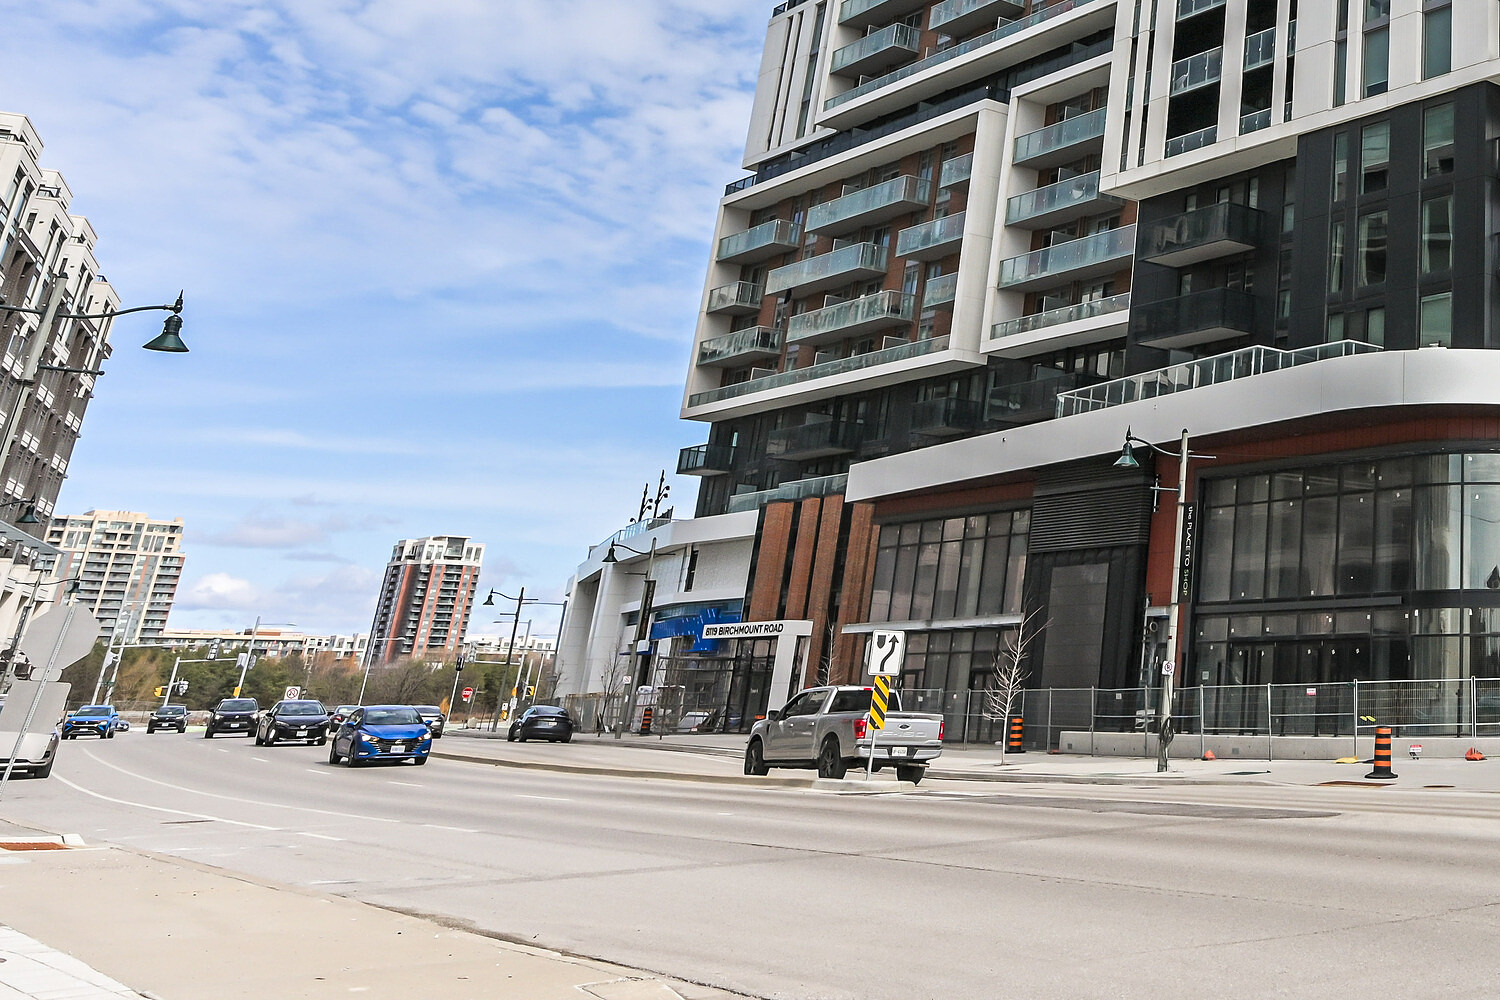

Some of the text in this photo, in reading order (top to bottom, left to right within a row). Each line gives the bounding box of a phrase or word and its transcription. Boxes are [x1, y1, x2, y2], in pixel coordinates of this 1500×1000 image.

[1185, 522, 1193, 551] PLACE
[1184, 552, 1190, 567] TO
[718, 624, 763, 636] BIRCHMOUNT
[763, 623, 784, 634] ROAD
